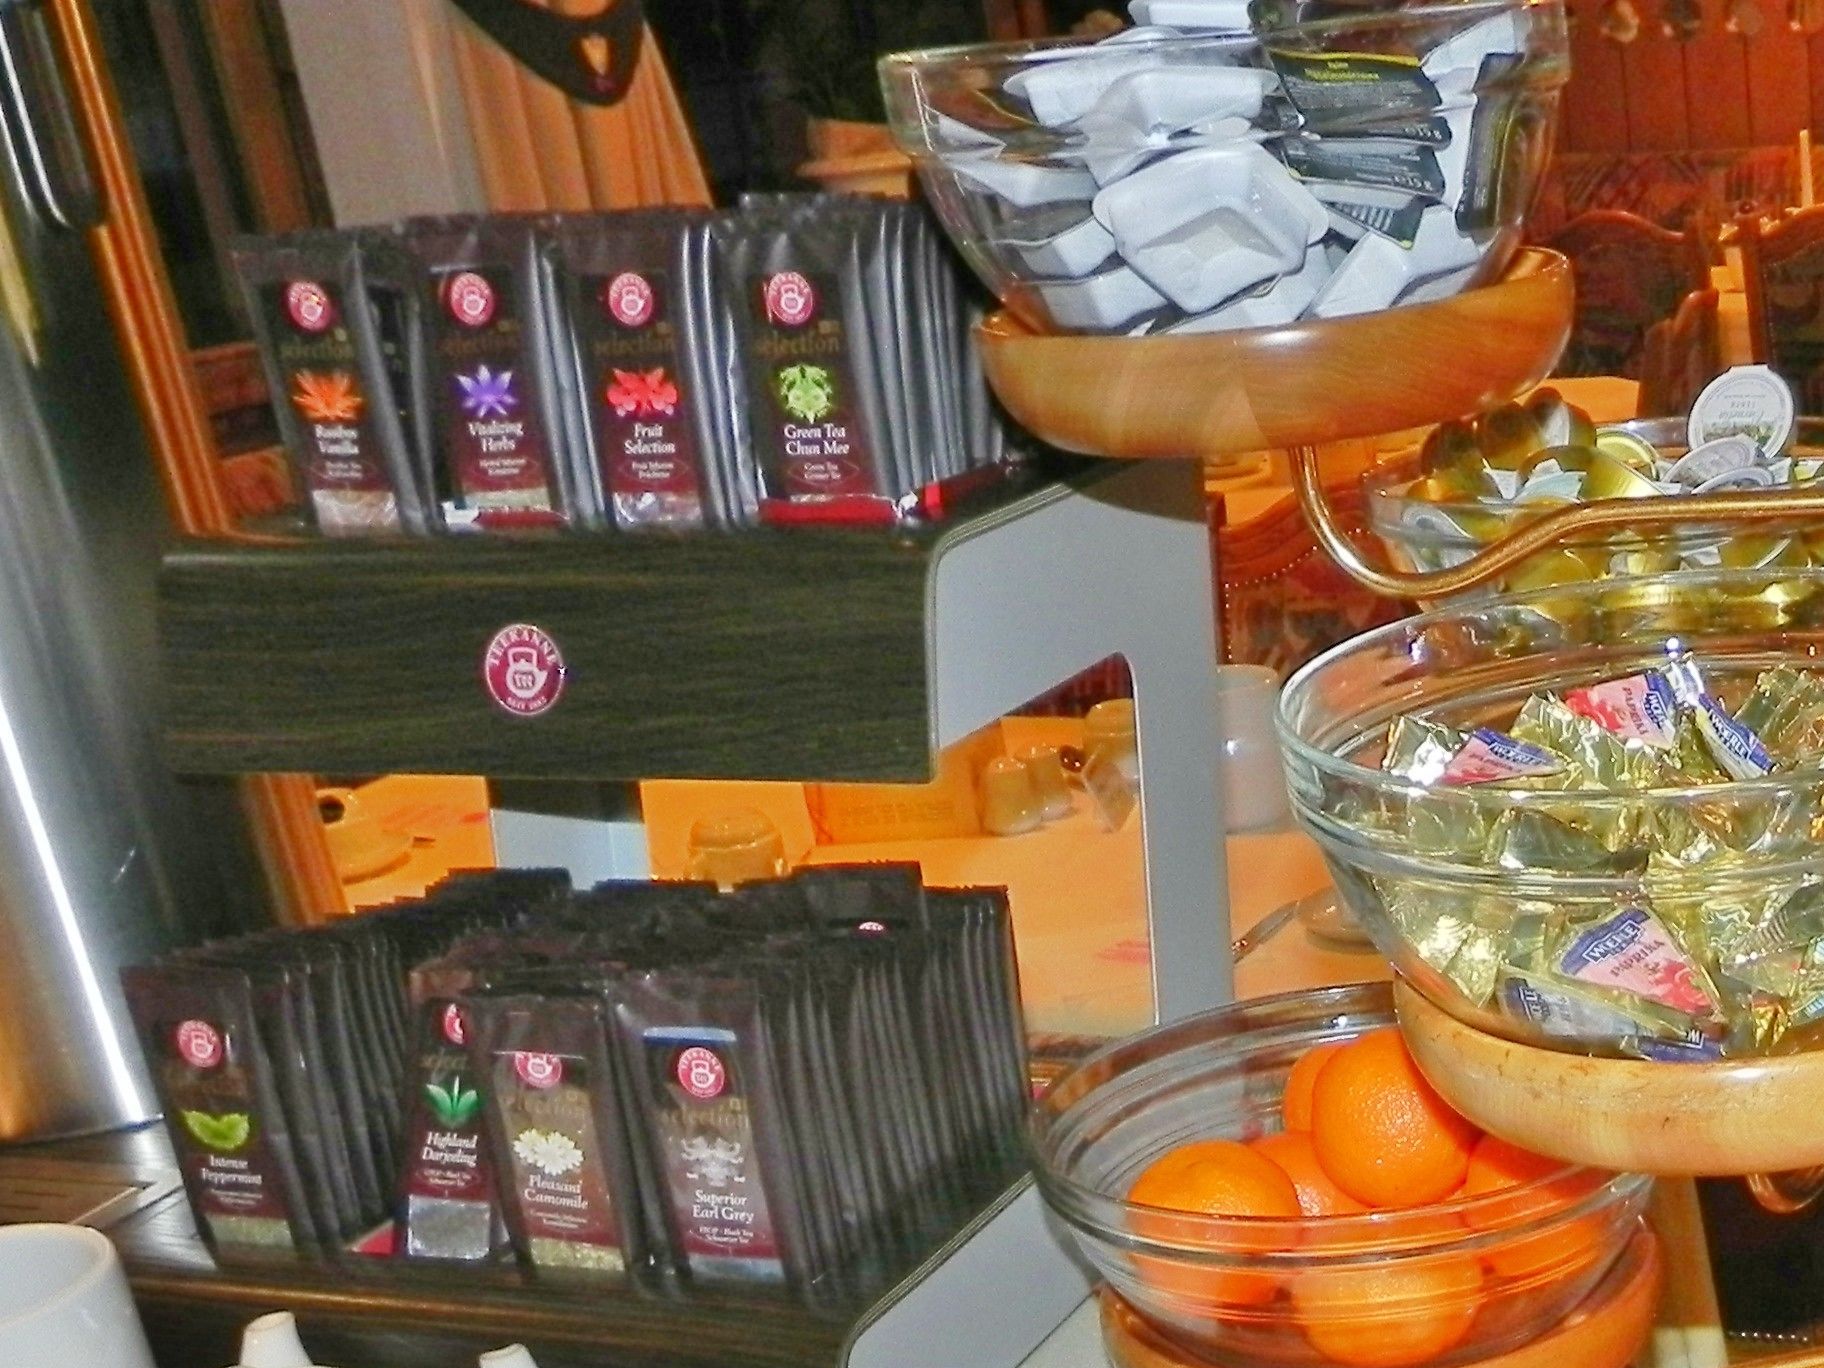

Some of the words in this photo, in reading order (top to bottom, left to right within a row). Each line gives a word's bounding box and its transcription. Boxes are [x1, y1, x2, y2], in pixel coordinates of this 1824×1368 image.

[634, 424, 664, 438] Fruit
[784, 423, 822, 439] Green
[825, 423, 846, 438] Tea
[624, 439, 677, 455] Selection
[823, 440, 850, 455] Mee
[1610, 938, 1666, 978] PAPRIKA
[528, 1174, 583, 1194] Pleasant
[523, 1188, 590, 1210] Camomile
[695, 1189, 749, 1208] Superior
[692, 1204, 720, 1220] Earl
[721, 1206, 755, 1224] Grey
